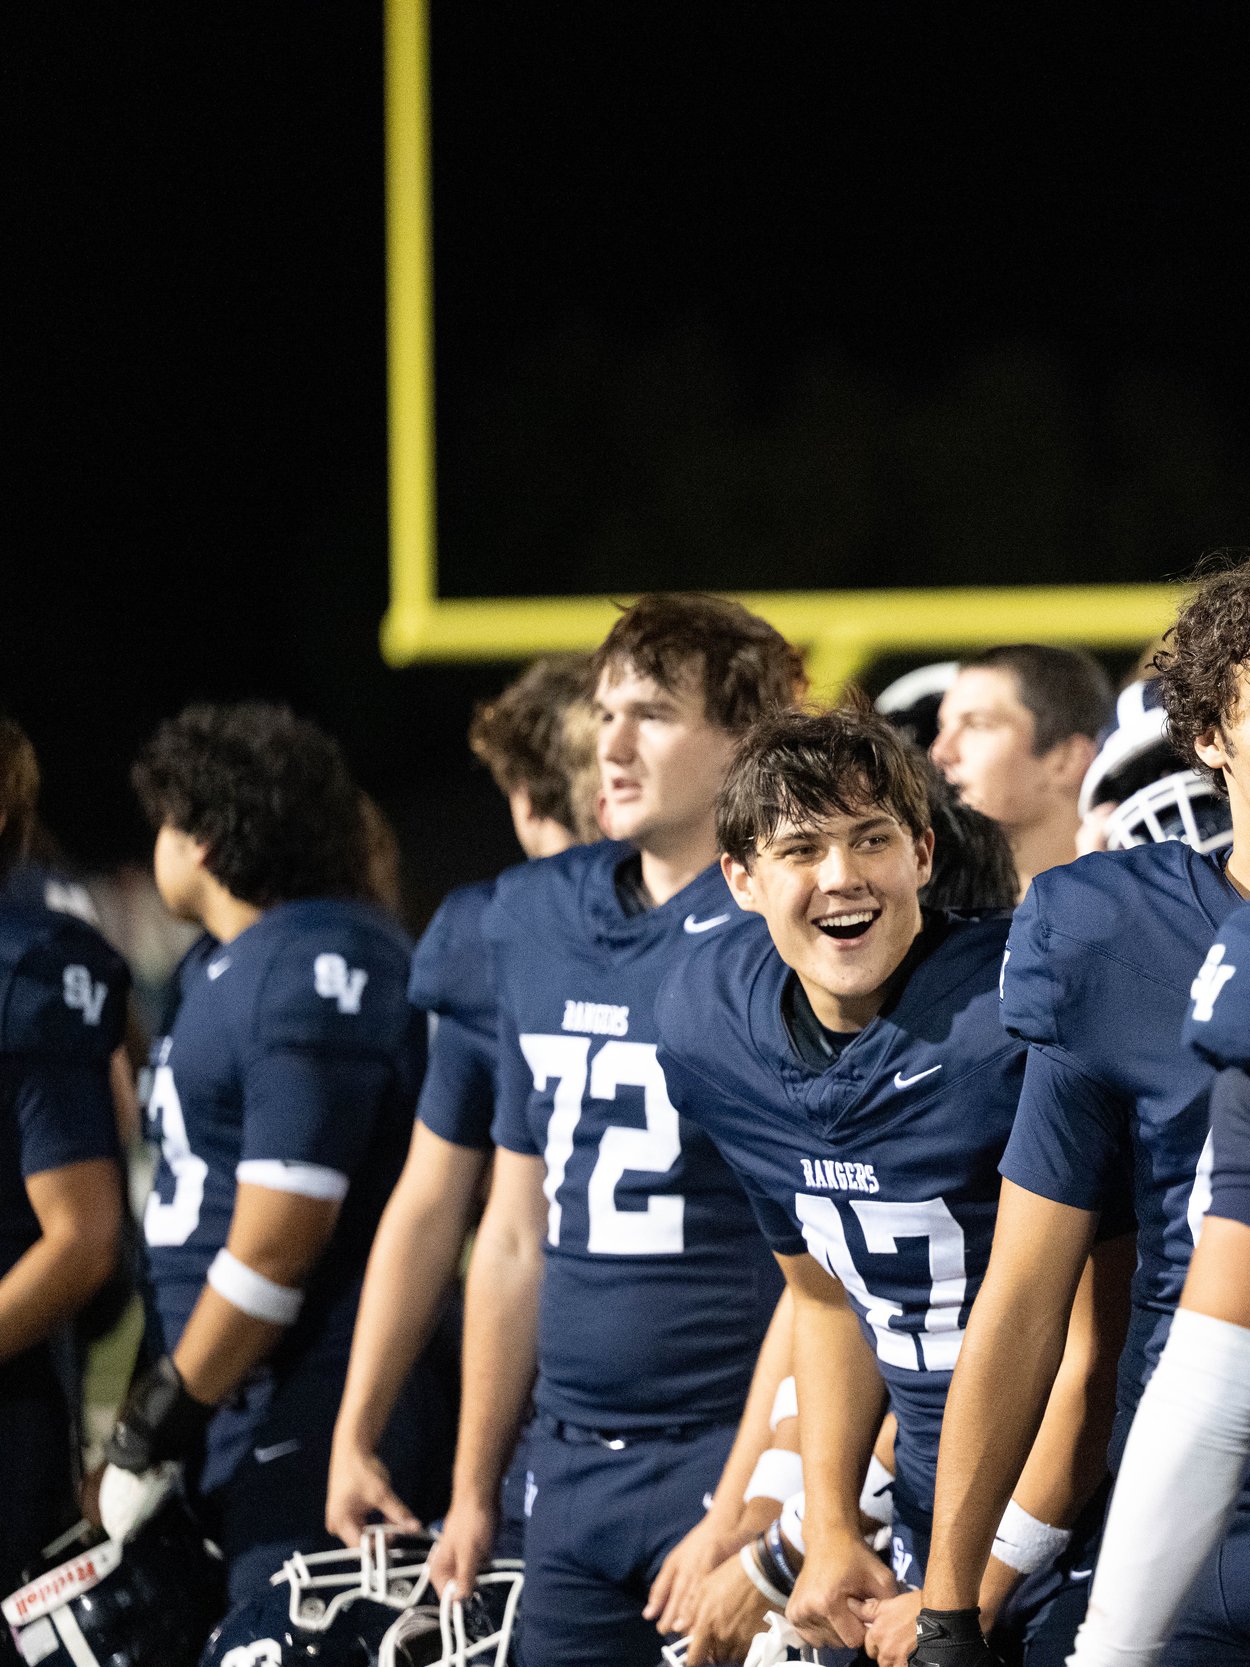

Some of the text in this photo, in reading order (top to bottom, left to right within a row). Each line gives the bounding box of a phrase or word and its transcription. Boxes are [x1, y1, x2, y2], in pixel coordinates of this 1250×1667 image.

[561, 1000, 630, 1036] RANGERS
[519, 1033, 685, 1255] 72
[800, 1158, 880, 1195] RANGERS
